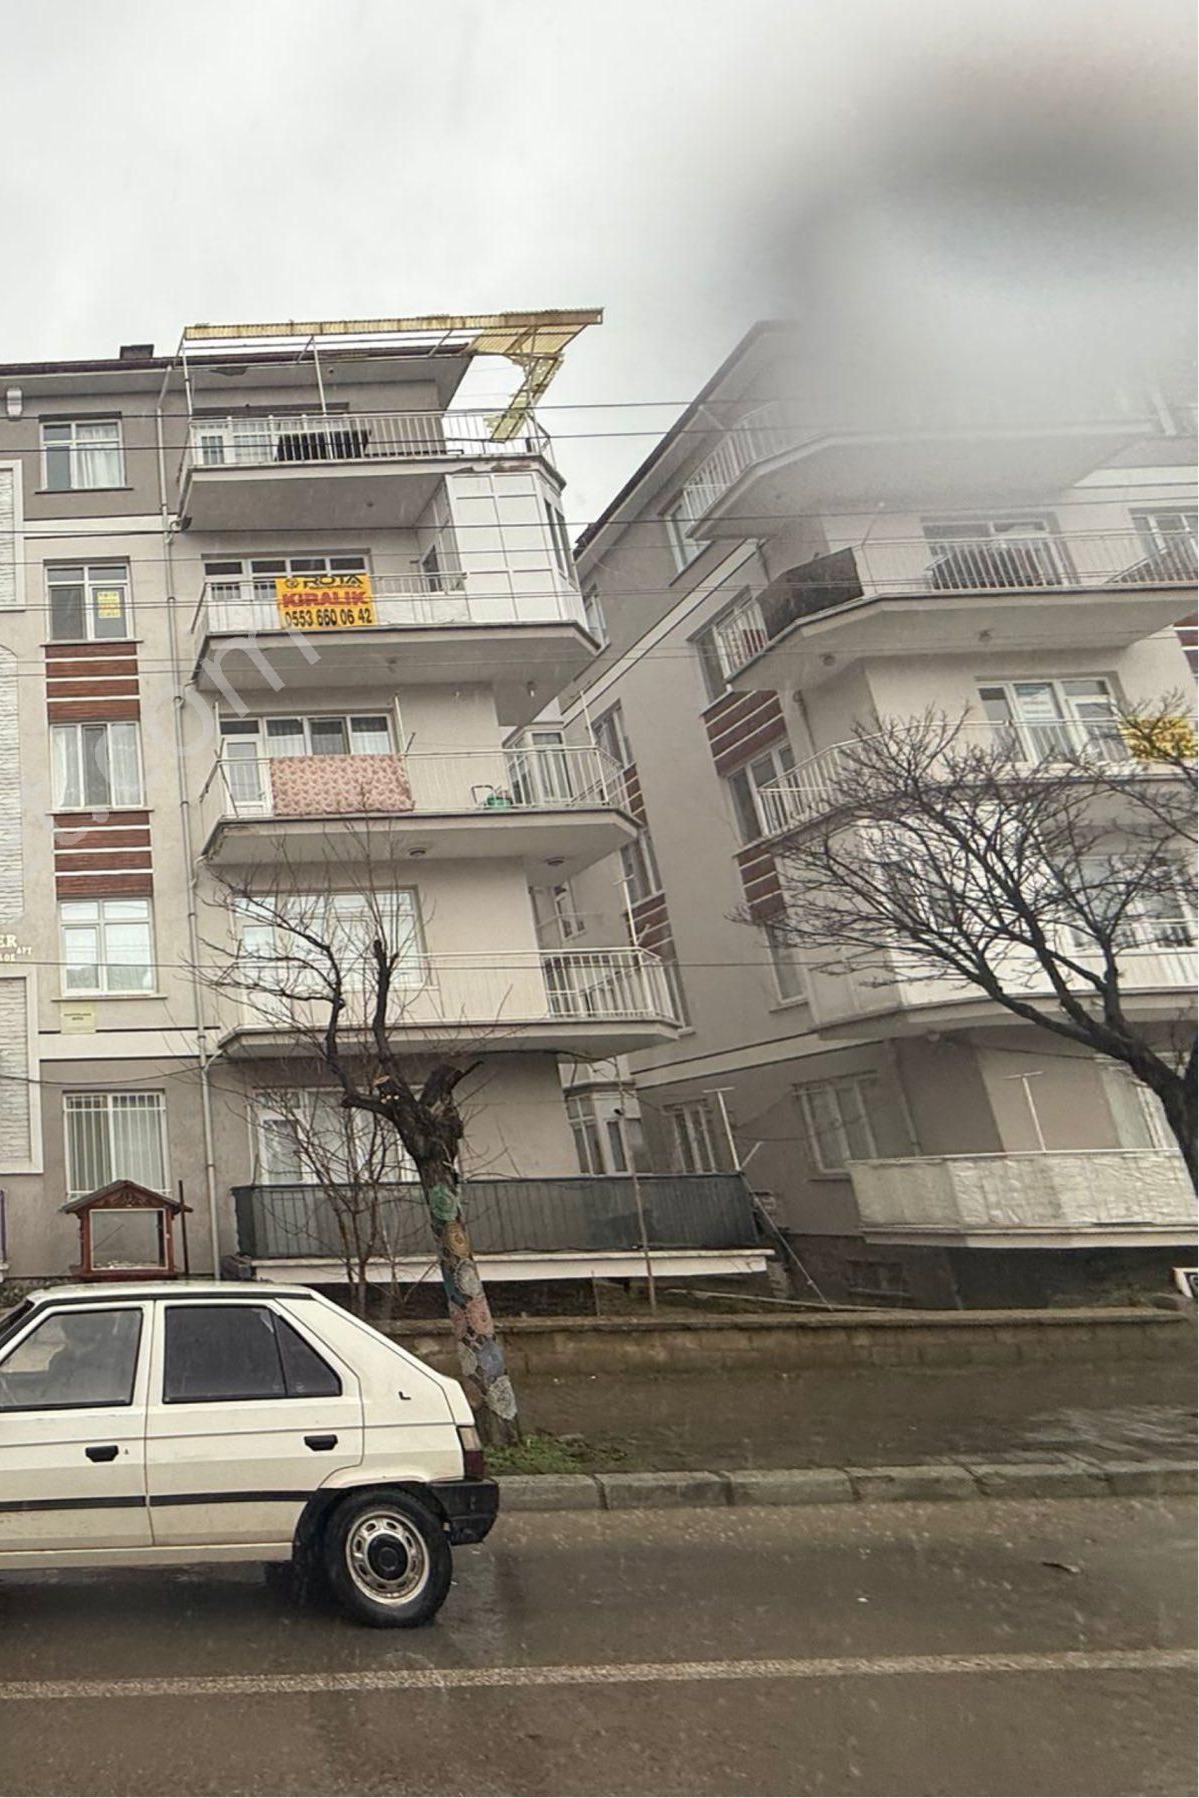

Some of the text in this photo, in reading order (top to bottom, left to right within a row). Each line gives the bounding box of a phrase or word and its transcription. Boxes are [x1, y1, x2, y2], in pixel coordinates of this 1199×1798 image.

[283, 591, 369, 607] KIRALIK
[285, 607, 372, 628] 0553 660 06 42
